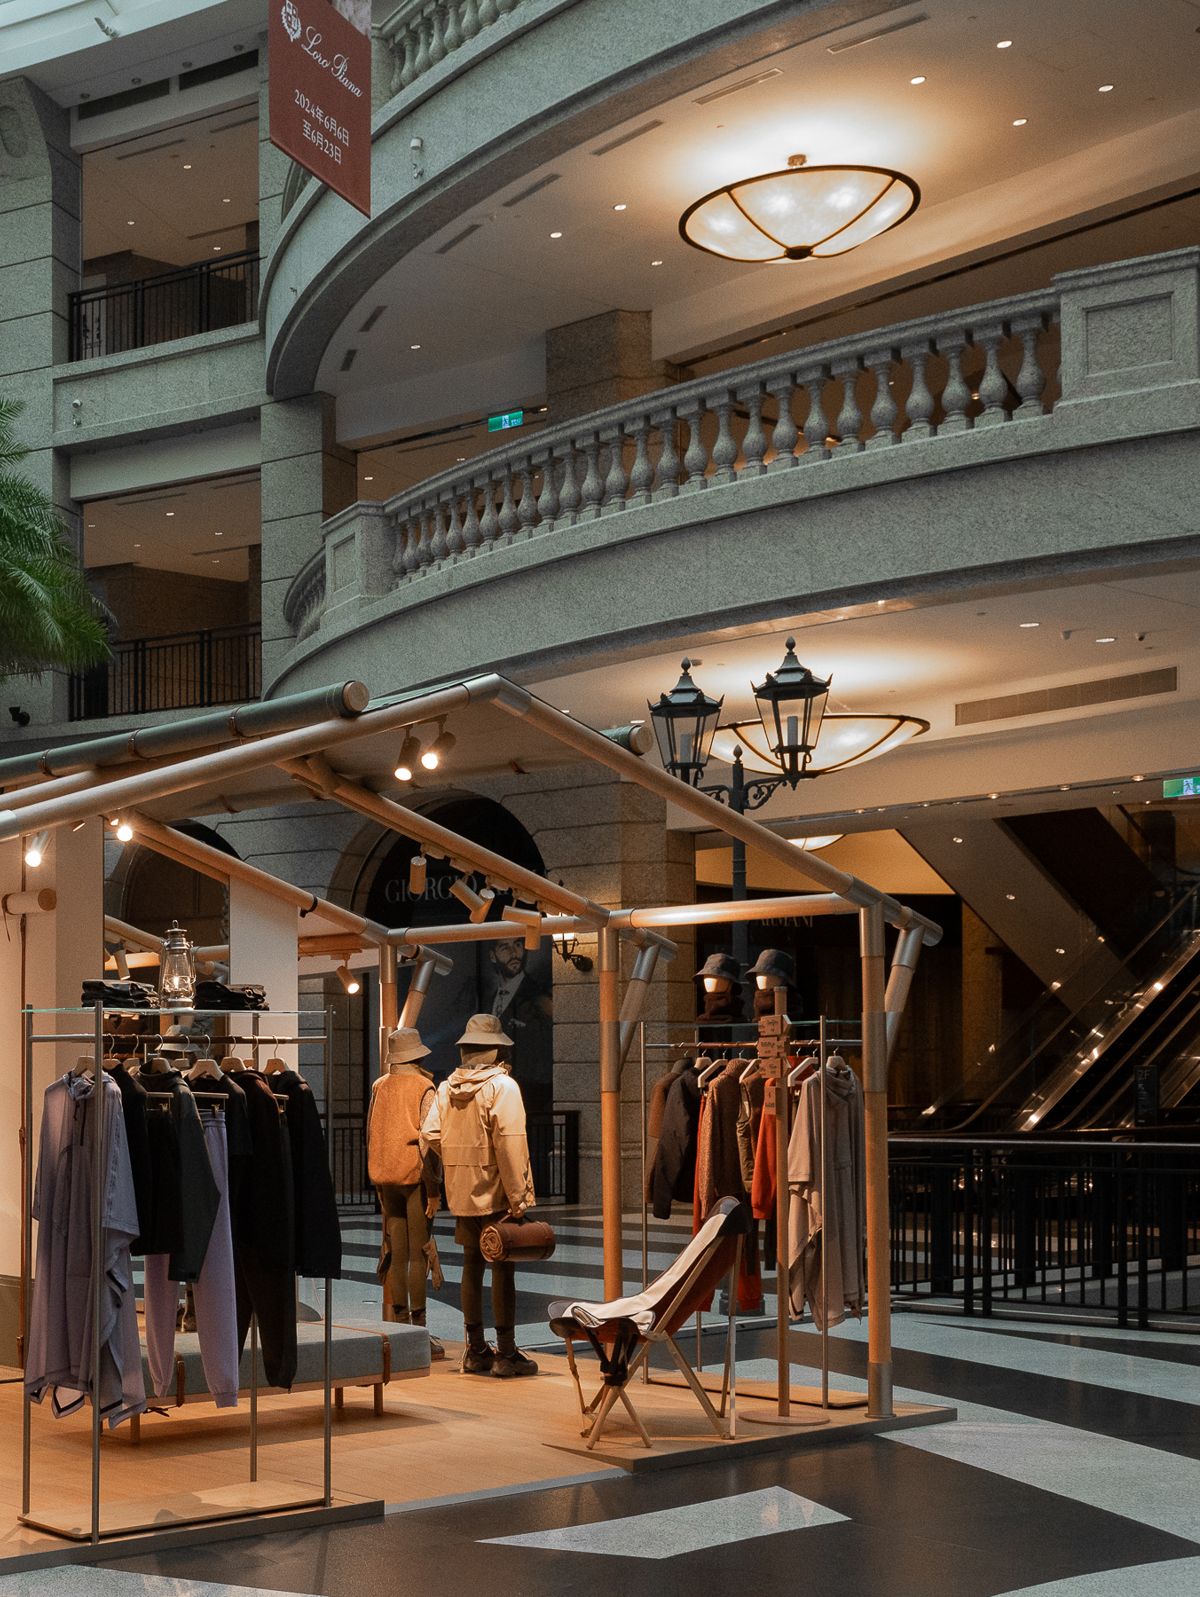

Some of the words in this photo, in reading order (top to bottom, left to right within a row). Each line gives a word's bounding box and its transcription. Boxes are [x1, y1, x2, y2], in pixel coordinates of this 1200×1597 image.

[301, 26, 330, 69] Loro
[331, 53, 363, 98] Piana
[294, 89, 350, 146] 2024年6月6日
[302, 119, 342, 165] 至6月23日
[384, 874, 478, 904] GIRGO
